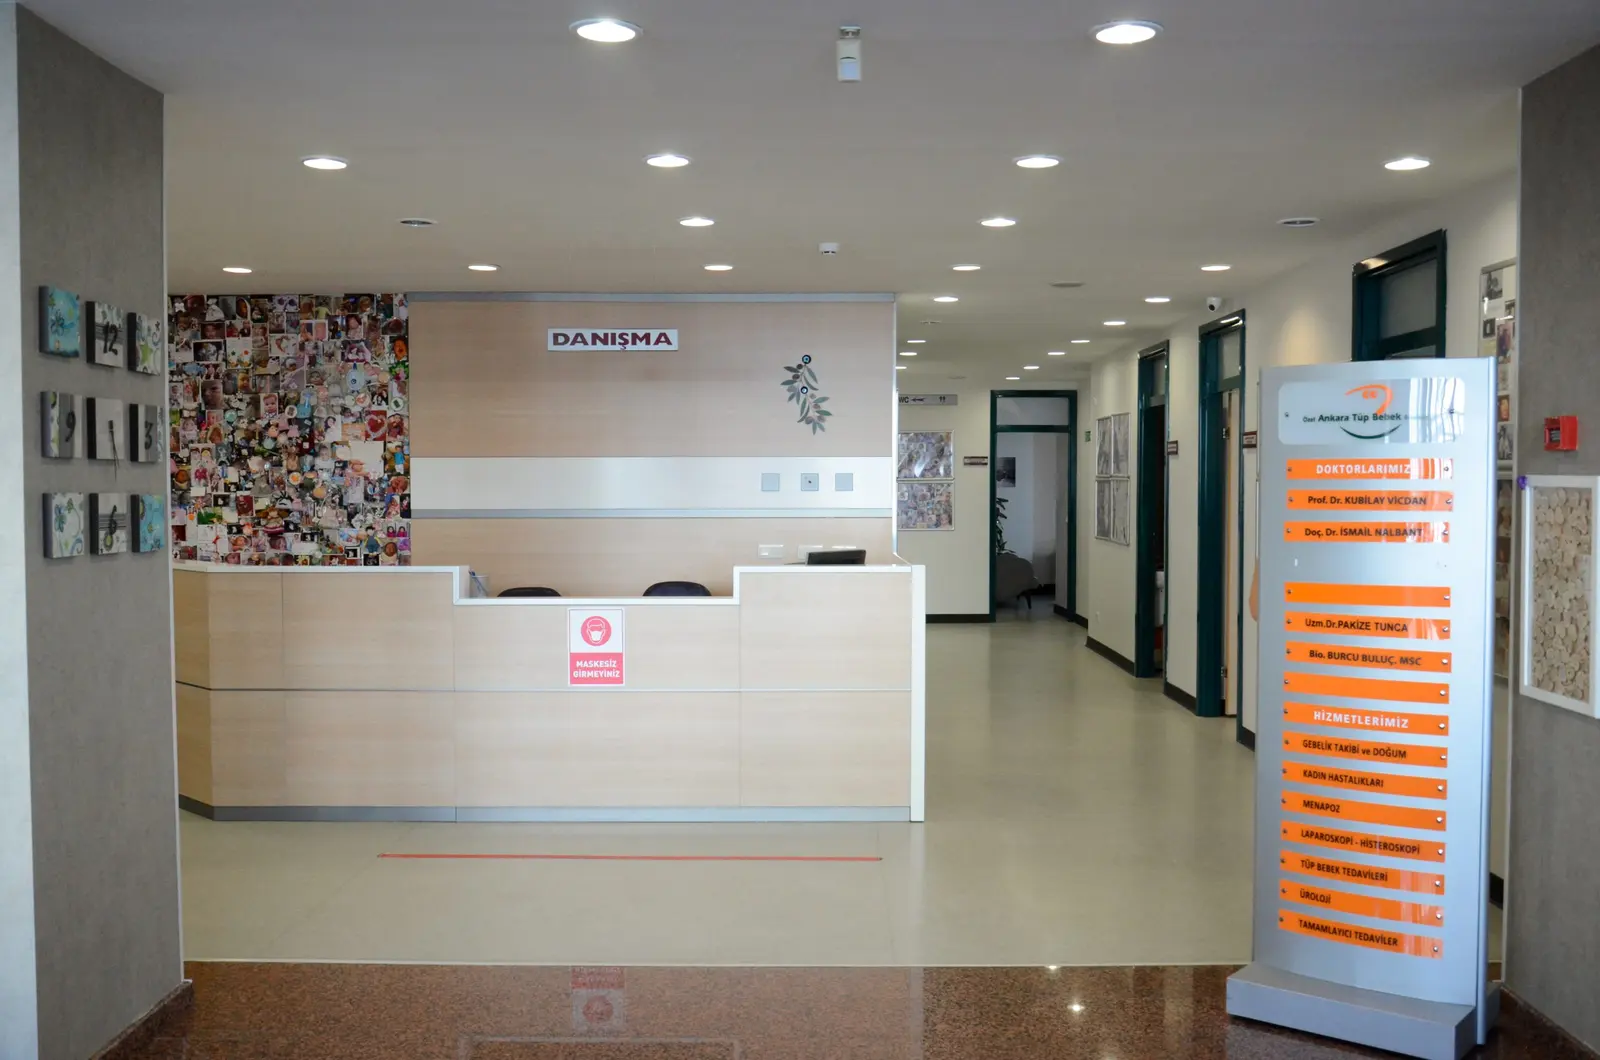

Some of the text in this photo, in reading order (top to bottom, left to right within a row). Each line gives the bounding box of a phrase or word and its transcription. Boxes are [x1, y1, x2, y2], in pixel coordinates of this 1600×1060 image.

[103, 319, 118, 356] 12
[552, 332, 673, 350] DANIŞMA
[898, 396, 910, 404] WC
[65, 410, 76, 443] 9
[1318, 414, 1350, 422] Ankara
[1352, 412, 1370, 424] Tüp
[1372, 412, 1402, 421] Bebek
[144, 420, 154, 450] 3
[1316, 463, 1412, 475] DOKTORLARIMIZ
[1307, 494, 1427, 505] Prof. Dr. KUBİLAY VİCDAN
[108, 504, 118, 537] 6
[1304, 526, 1423, 538] Doç. Dr. İSMAİL NALBANT
[1304, 618, 1409, 632] Uzm.Dr.PAKİZE TUNCA
[575, 658, 618, 668] MASKESİZ
[1308, 649, 1326, 659] Bio.
[1327, 651, 1360, 662] BURCU
[572, 668, 621, 679] GİRMEYİNİZ
[1313, 709, 1409, 729] HİZMETLERİMİZ
[1302, 739, 1333, 752] GEBELİK
[1334, 742, 1360, 755] TAKİBİ
[1372, 747, 1407, 759] DOĞUM
[1302, 769, 1384, 788] KADIN HASTALIKLARI
[1302, 799, 1341, 813] MENAPOZ
[1301, 829, 1354, 846] LAPAROSKOPİ
[1360, 838, 1421, 856] HİSTEROSKOPİ
[1300, 859, 1389, 882] TÜP BEBEK TEDAVİLERİ
[1299, 887, 1332, 905] ÜROLOJİ
[1299, 919, 1399, 947] TAMAMLAYICI TEDAVİLER
